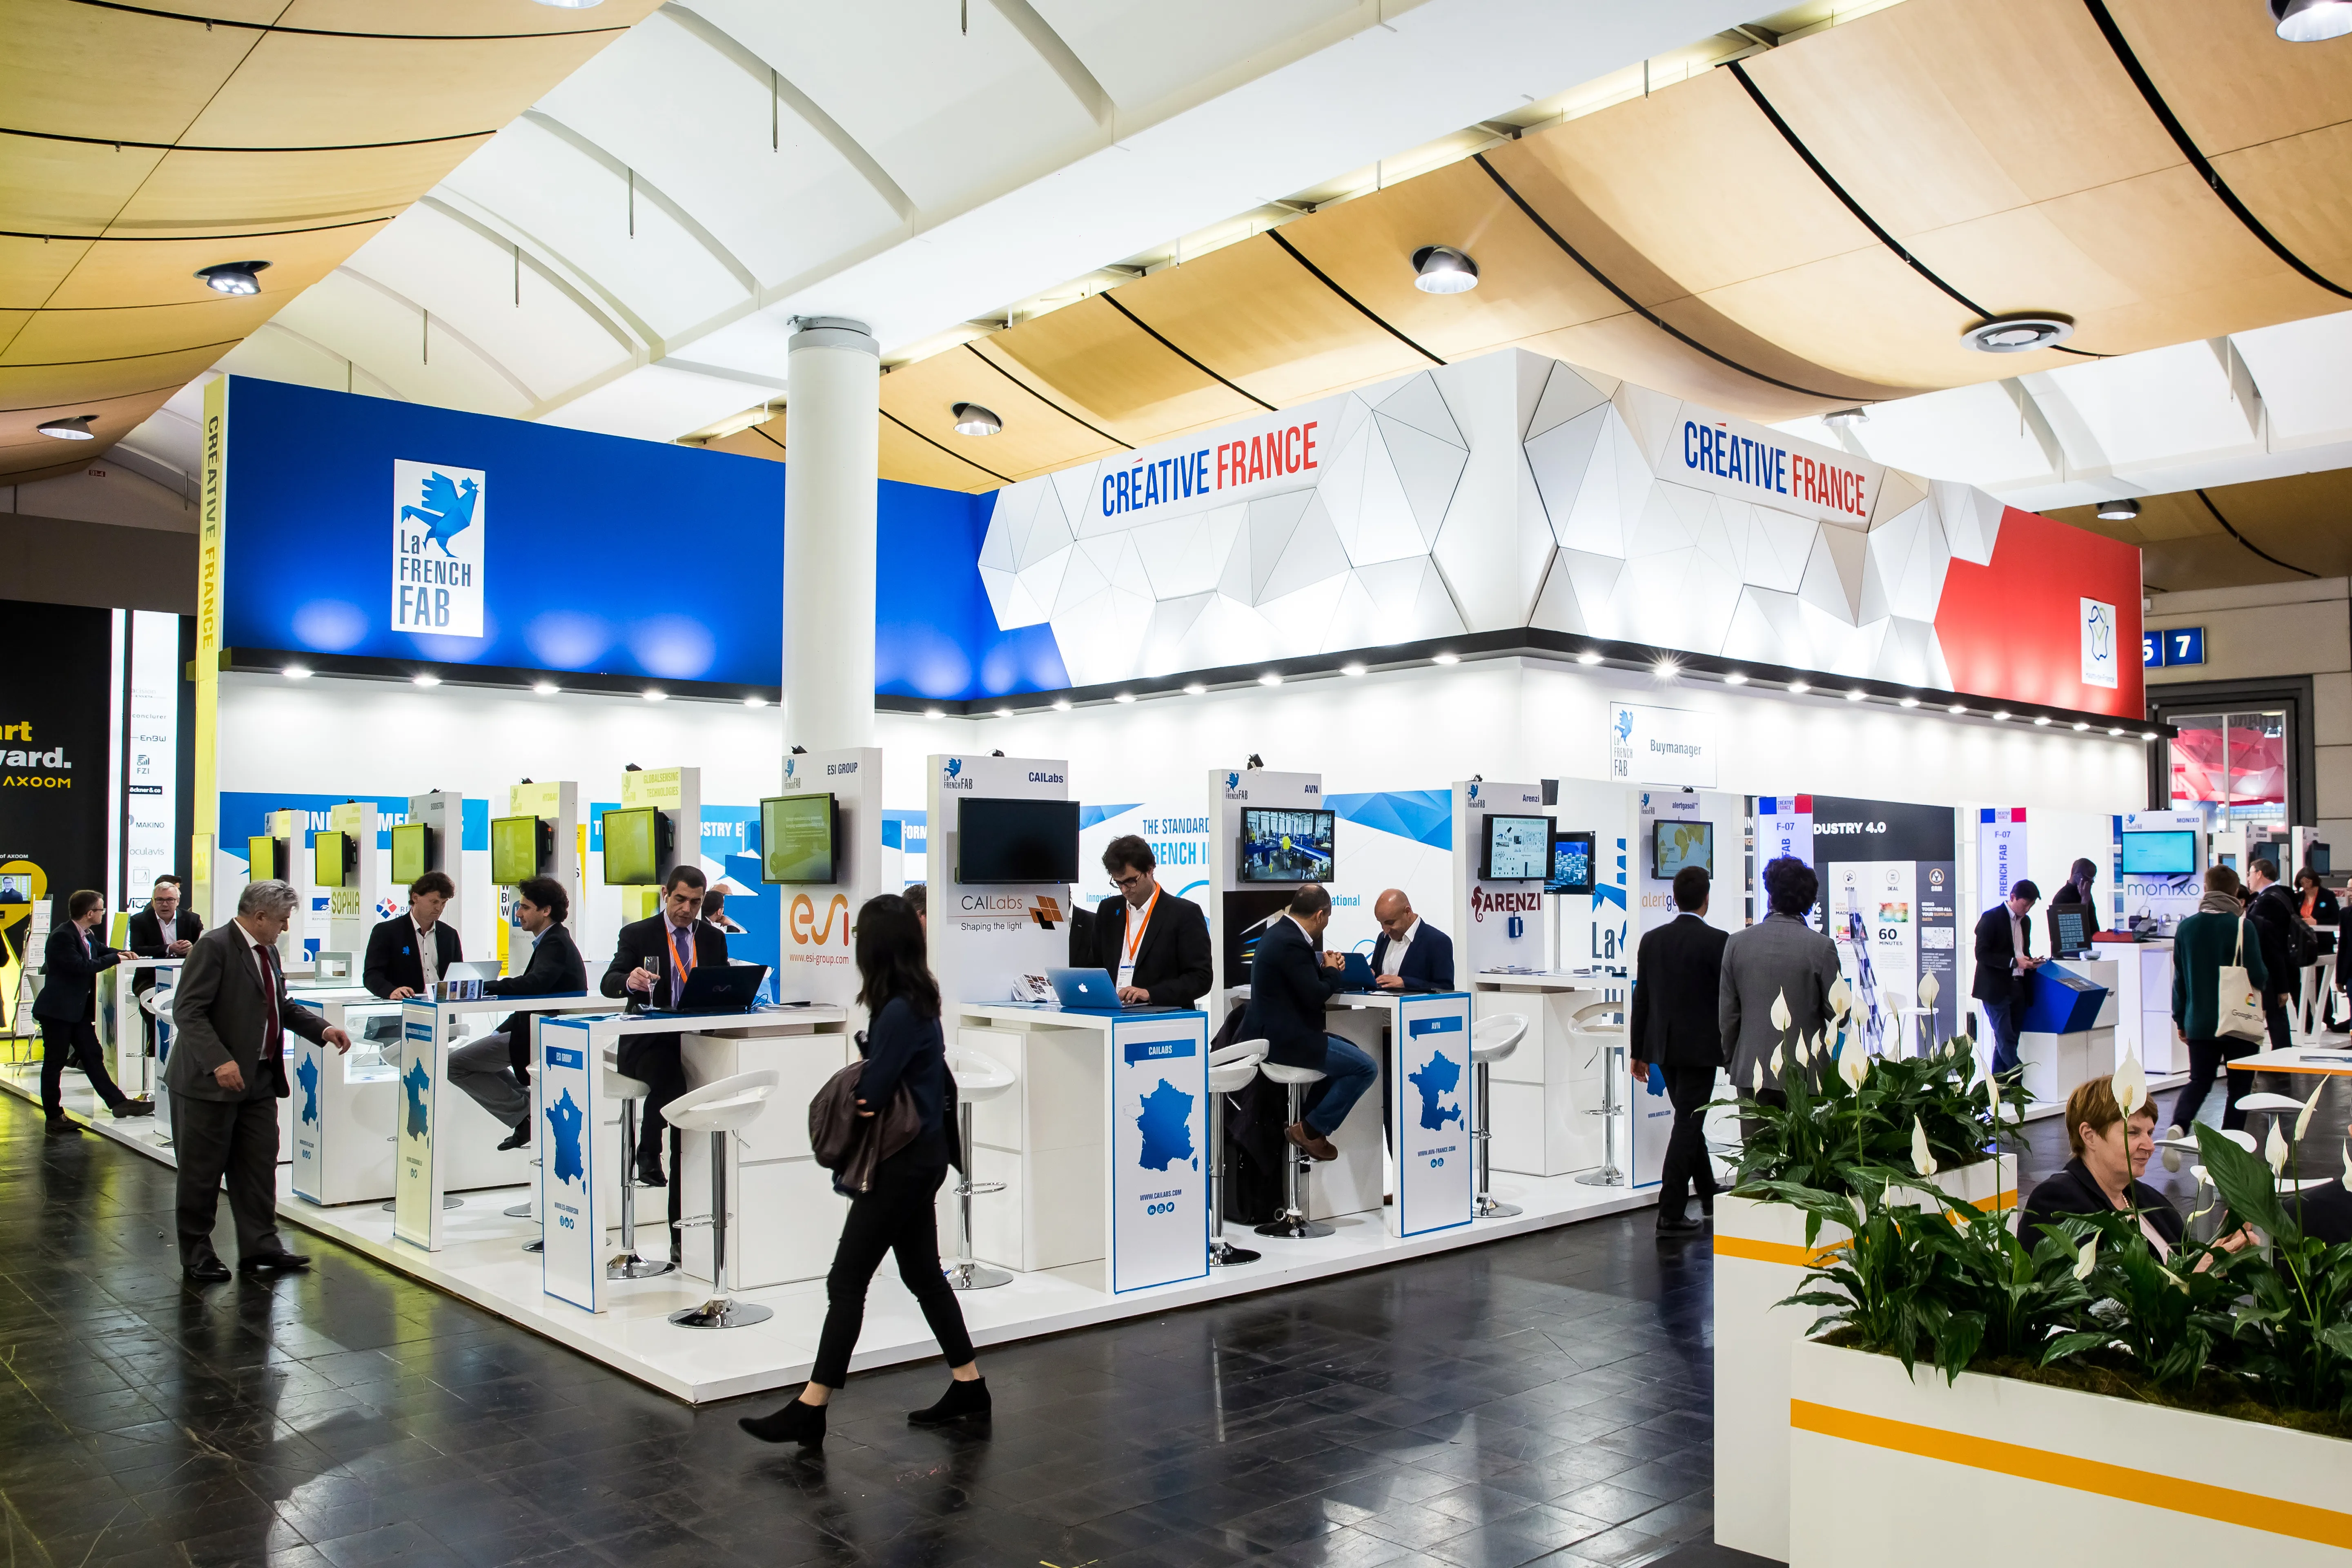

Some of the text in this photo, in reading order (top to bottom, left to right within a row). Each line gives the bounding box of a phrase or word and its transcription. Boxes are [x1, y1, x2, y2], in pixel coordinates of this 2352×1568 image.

[1102, 421, 1318, 517] CRÉATIVE FRANCE
[1684, 421, 1866, 517] CRÉATIVE FRANCE
[401, 530, 421, 555] La
[400, 557, 472, 588] FRENCH
[203, 546, 215, 648] FRANCE
[399, 585, 450, 628] FAB
[2175, 635, 2191, 658] 7
[0, 721, 32, 742] rt
[1614, 736, 1620, 746] La
[1614, 746, 1633, 759] FRENCH
[1650, 739, 1702, 757] Buymanager
[827, 762, 858, 775] ESI GROUP
[1614, 759, 1628, 777] FAB
[3, 776, 71, 788] AXOOM
[643, 771, 679, 784] GLOBALSENSING
[944, 777, 973, 790] FRENCH FAB
[1028, 771, 1064, 784] CAILabs
[646, 786, 679, 798] TECHNOLOGIES
[1238, 790, 1248, 800] FAB
[1304, 784, 1319, 794] AVN
[1522, 794, 1540, 802] Arenzi
[700, 822, 733, 837] STRY
[1143, 819, 1159, 835] THE
[1776, 822, 1795, 831] F-07
[1865, 821, 1887, 834] 4.0
[129, 847, 165, 856] oculavis
[1999, 863, 2007, 896] FRENCH
[2127, 883, 2200, 896] monixo
[332, 891, 360, 915] SOPHIA
[961, 895, 1022, 911] CAILabs
[1482, 892, 1541, 912] ARENZI
[789, 893, 849, 947] esi
[960, 921, 1022, 933] Shaping the light
[1592, 921, 1615, 959] La
[1879, 928, 1898, 940] 60
[789, 952, 849, 966] www.esi-group.com
[1148, 1045, 1172, 1056] CAILABS
[1140, 1189, 1182, 1201] WWW.CAILABS.COM
